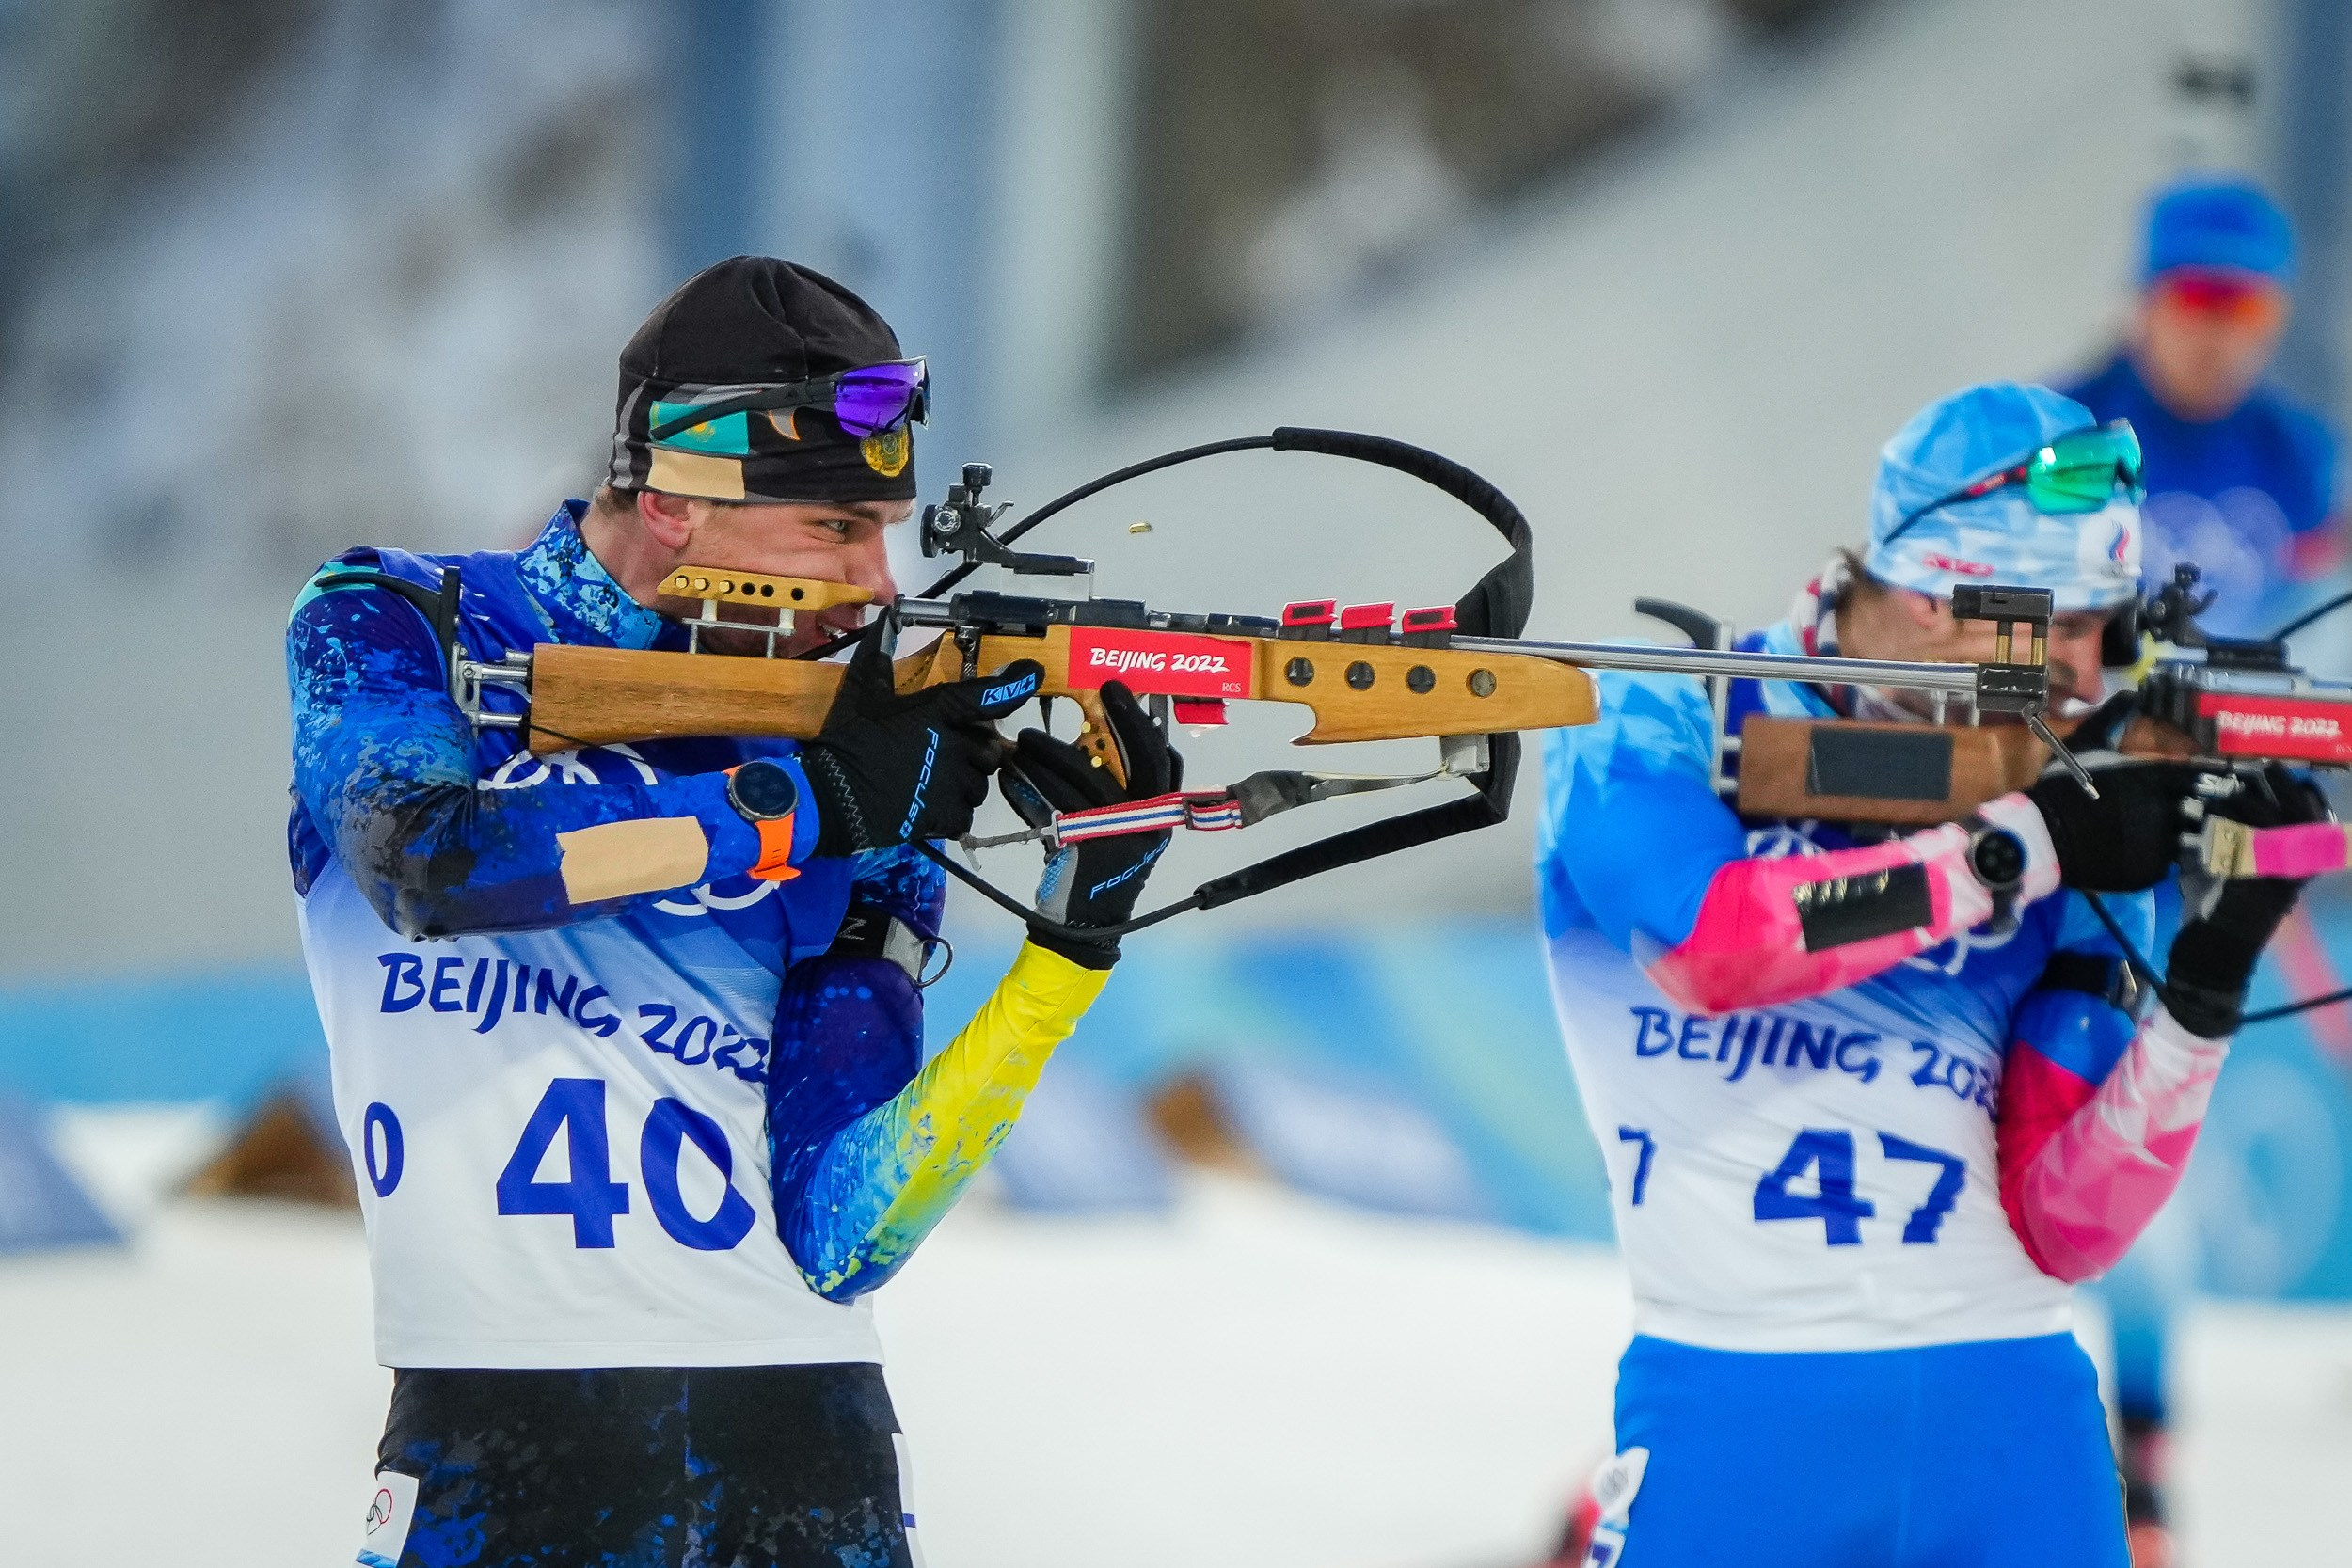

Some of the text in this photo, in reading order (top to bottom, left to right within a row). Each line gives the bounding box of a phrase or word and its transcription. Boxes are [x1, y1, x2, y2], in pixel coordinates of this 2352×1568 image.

[1090, 648, 1230, 673] BEIJING 2022
[1222, 682, 1241, 693] RCS
[2216, 711, 2344, 738] BEIJING 2022
[908, 727, 939, 823] FOCUS
[377, 953, 622, 1037] BEIJING
[1630, 1006, 1999, 1123] BEIJING 202
[496, 1077, 756, 1251] 40
[1753, 1127, 1966, 1245] 47
